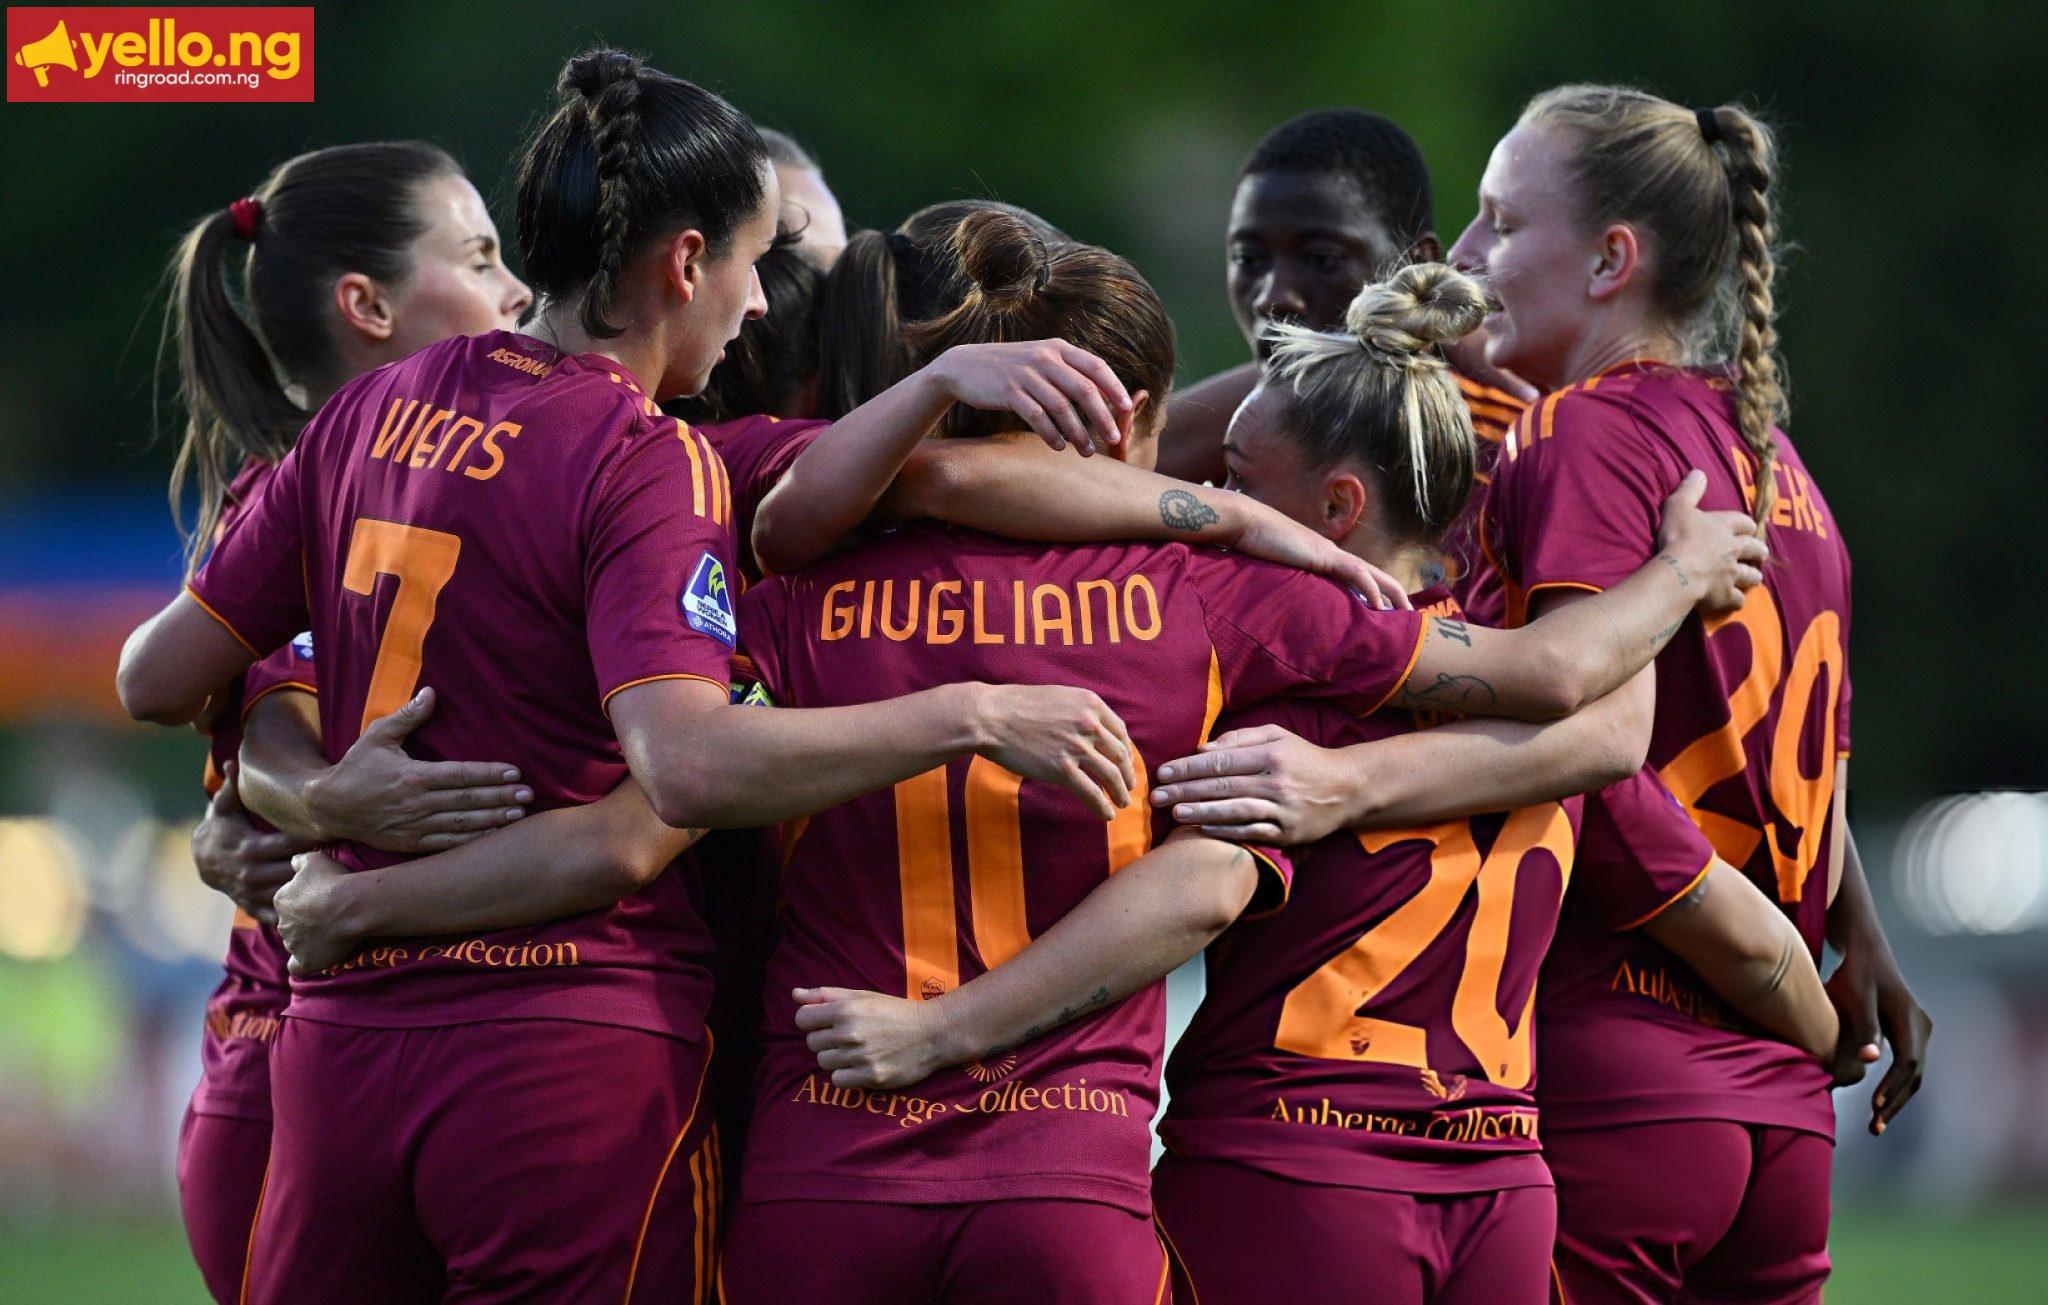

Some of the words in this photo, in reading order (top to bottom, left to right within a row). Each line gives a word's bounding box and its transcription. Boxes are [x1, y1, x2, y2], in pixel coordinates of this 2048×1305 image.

[371, 398, 523, 480] VIENS
[343, 518, 462, 736] 7
[704, 621, 732, 643] ATHORA
[820, 573, 1162, 646] GIUGLIANO
[1658, 583, 1843, 903] 29
[1273, 800, 1575, 1091] 20
[954, 1078, 1129, 1118] ollection
